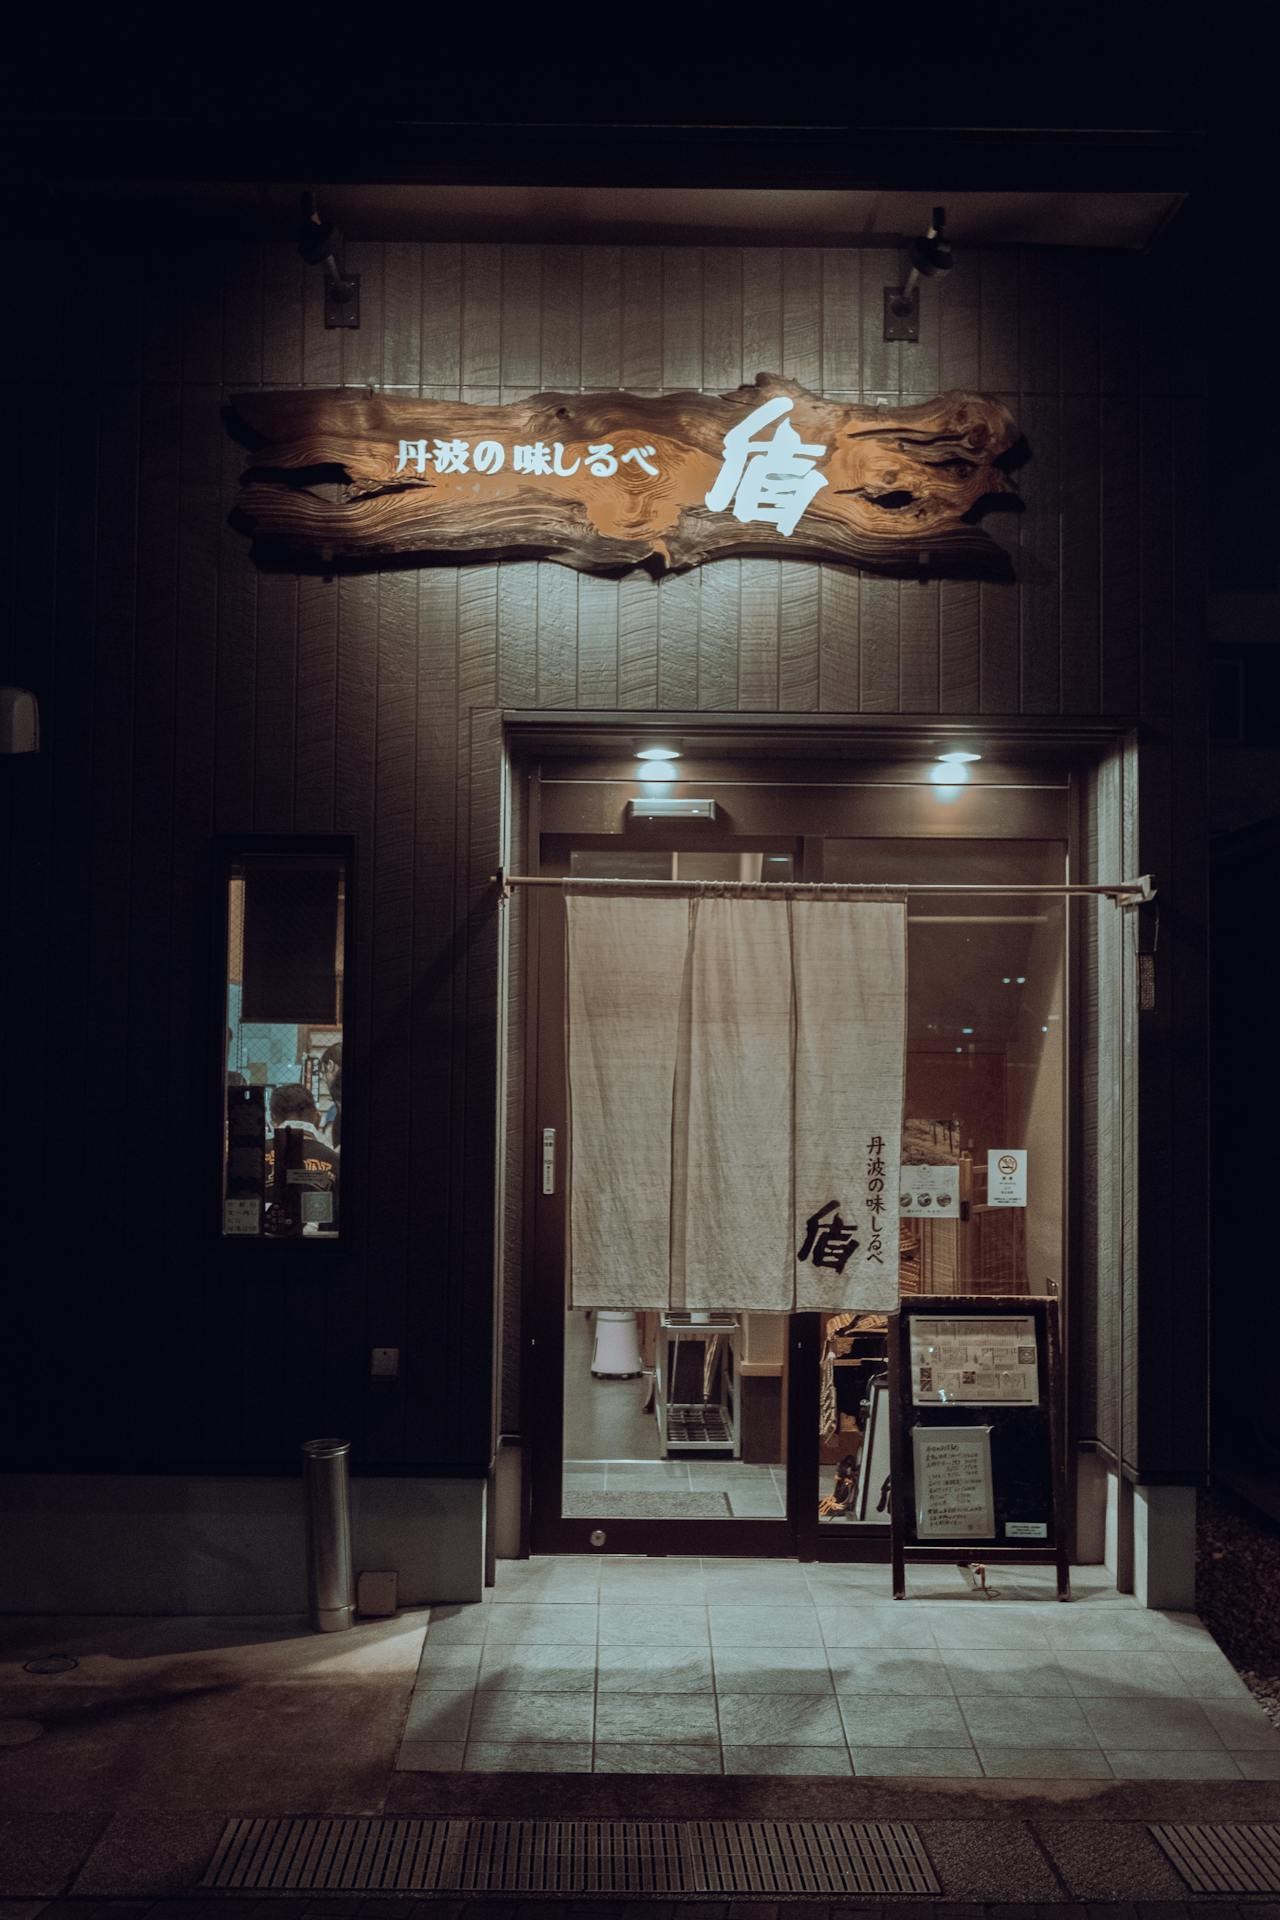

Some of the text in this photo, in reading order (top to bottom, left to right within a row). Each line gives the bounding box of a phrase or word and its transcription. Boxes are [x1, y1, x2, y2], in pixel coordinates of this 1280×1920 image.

[706, 396, 828, 536] 盾
[798, 1200, 859, 1275] 盾
[866, 1136, 886, 1264] 丹波の味しるべ
